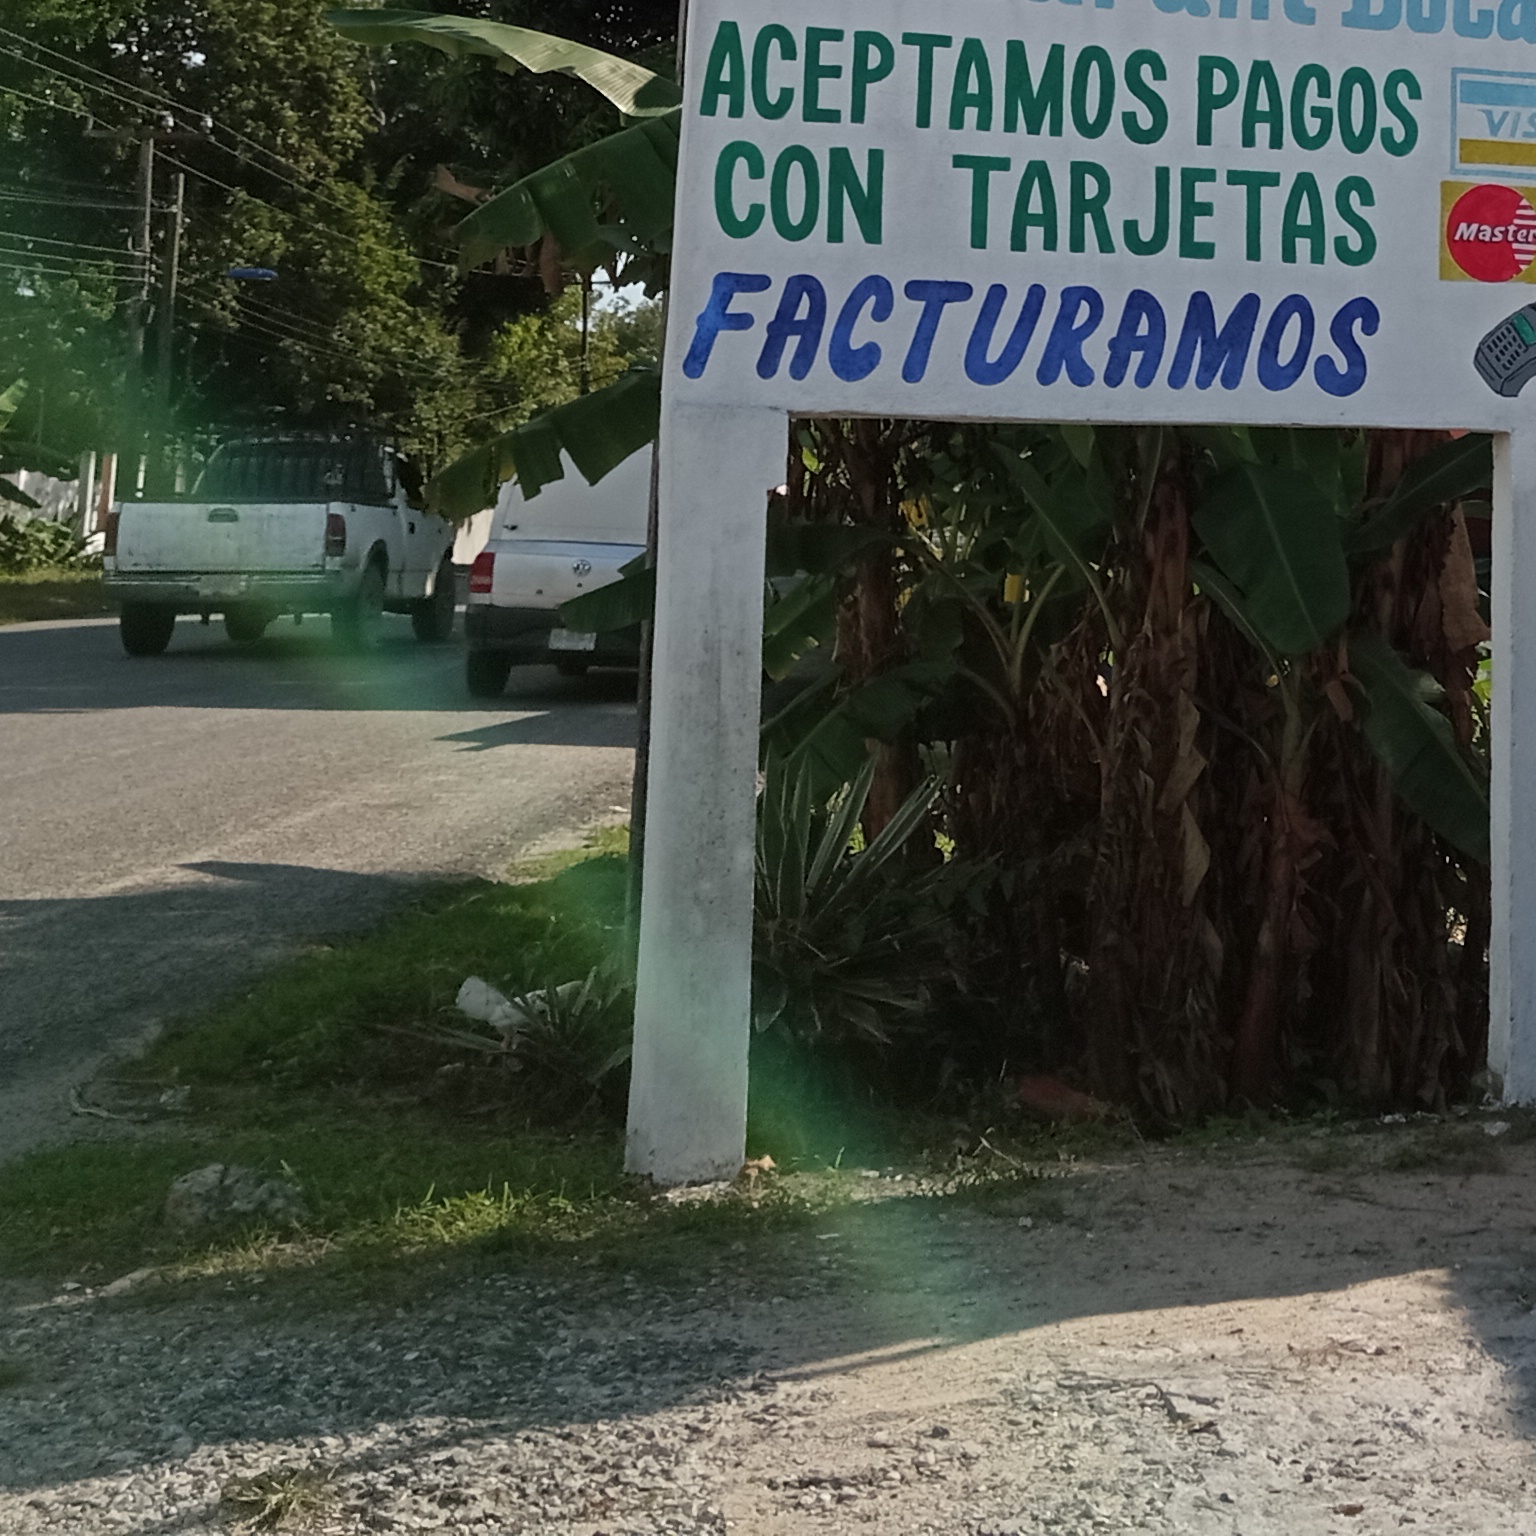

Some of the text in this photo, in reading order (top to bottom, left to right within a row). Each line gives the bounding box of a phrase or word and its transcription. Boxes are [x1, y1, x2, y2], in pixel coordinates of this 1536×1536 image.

[699, 20, 1423, 158] ACEPTAMOS PAGOS
[714, 140, 1377, 267] CON TARJETAS
[682, 272, 1381, 397] FACTURAMOS
